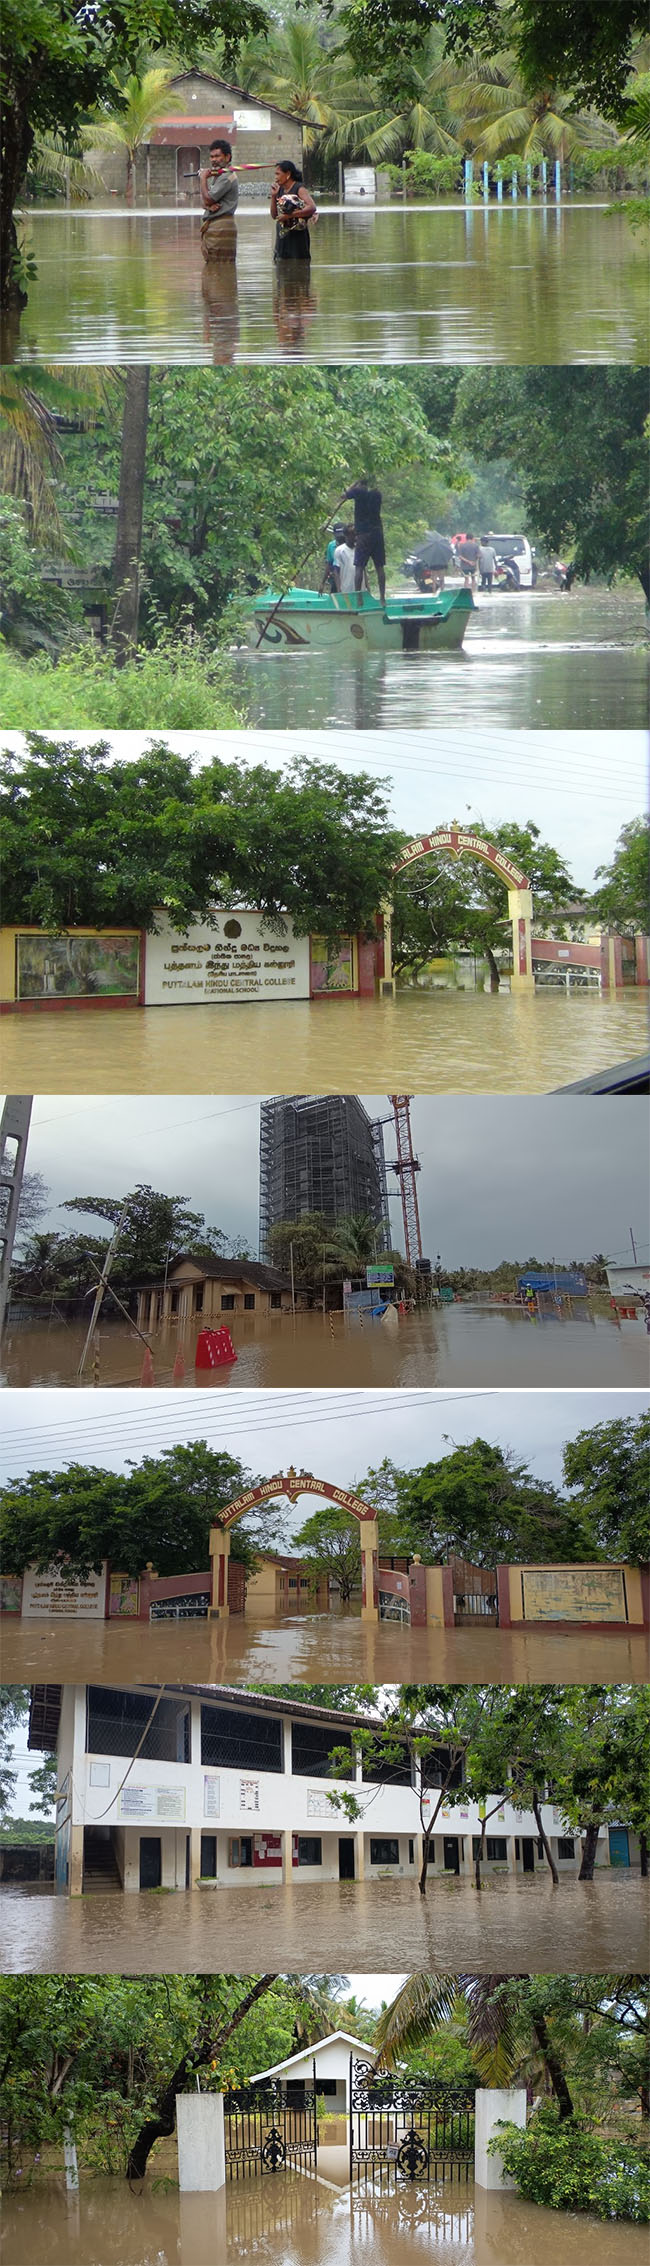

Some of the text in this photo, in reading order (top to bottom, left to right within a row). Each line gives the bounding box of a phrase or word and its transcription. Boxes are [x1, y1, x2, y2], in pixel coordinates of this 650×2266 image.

[429, 833, 452, 848] HINDU
[457, 835, 490, 855] CENTRAL
[494, 853, 524, 884] COLLEGE
[205, 979, 229, 987] HINDU
[218, 1479, 369, 1523] PUTTALAM HINDU CENTRAL COLLEGE
